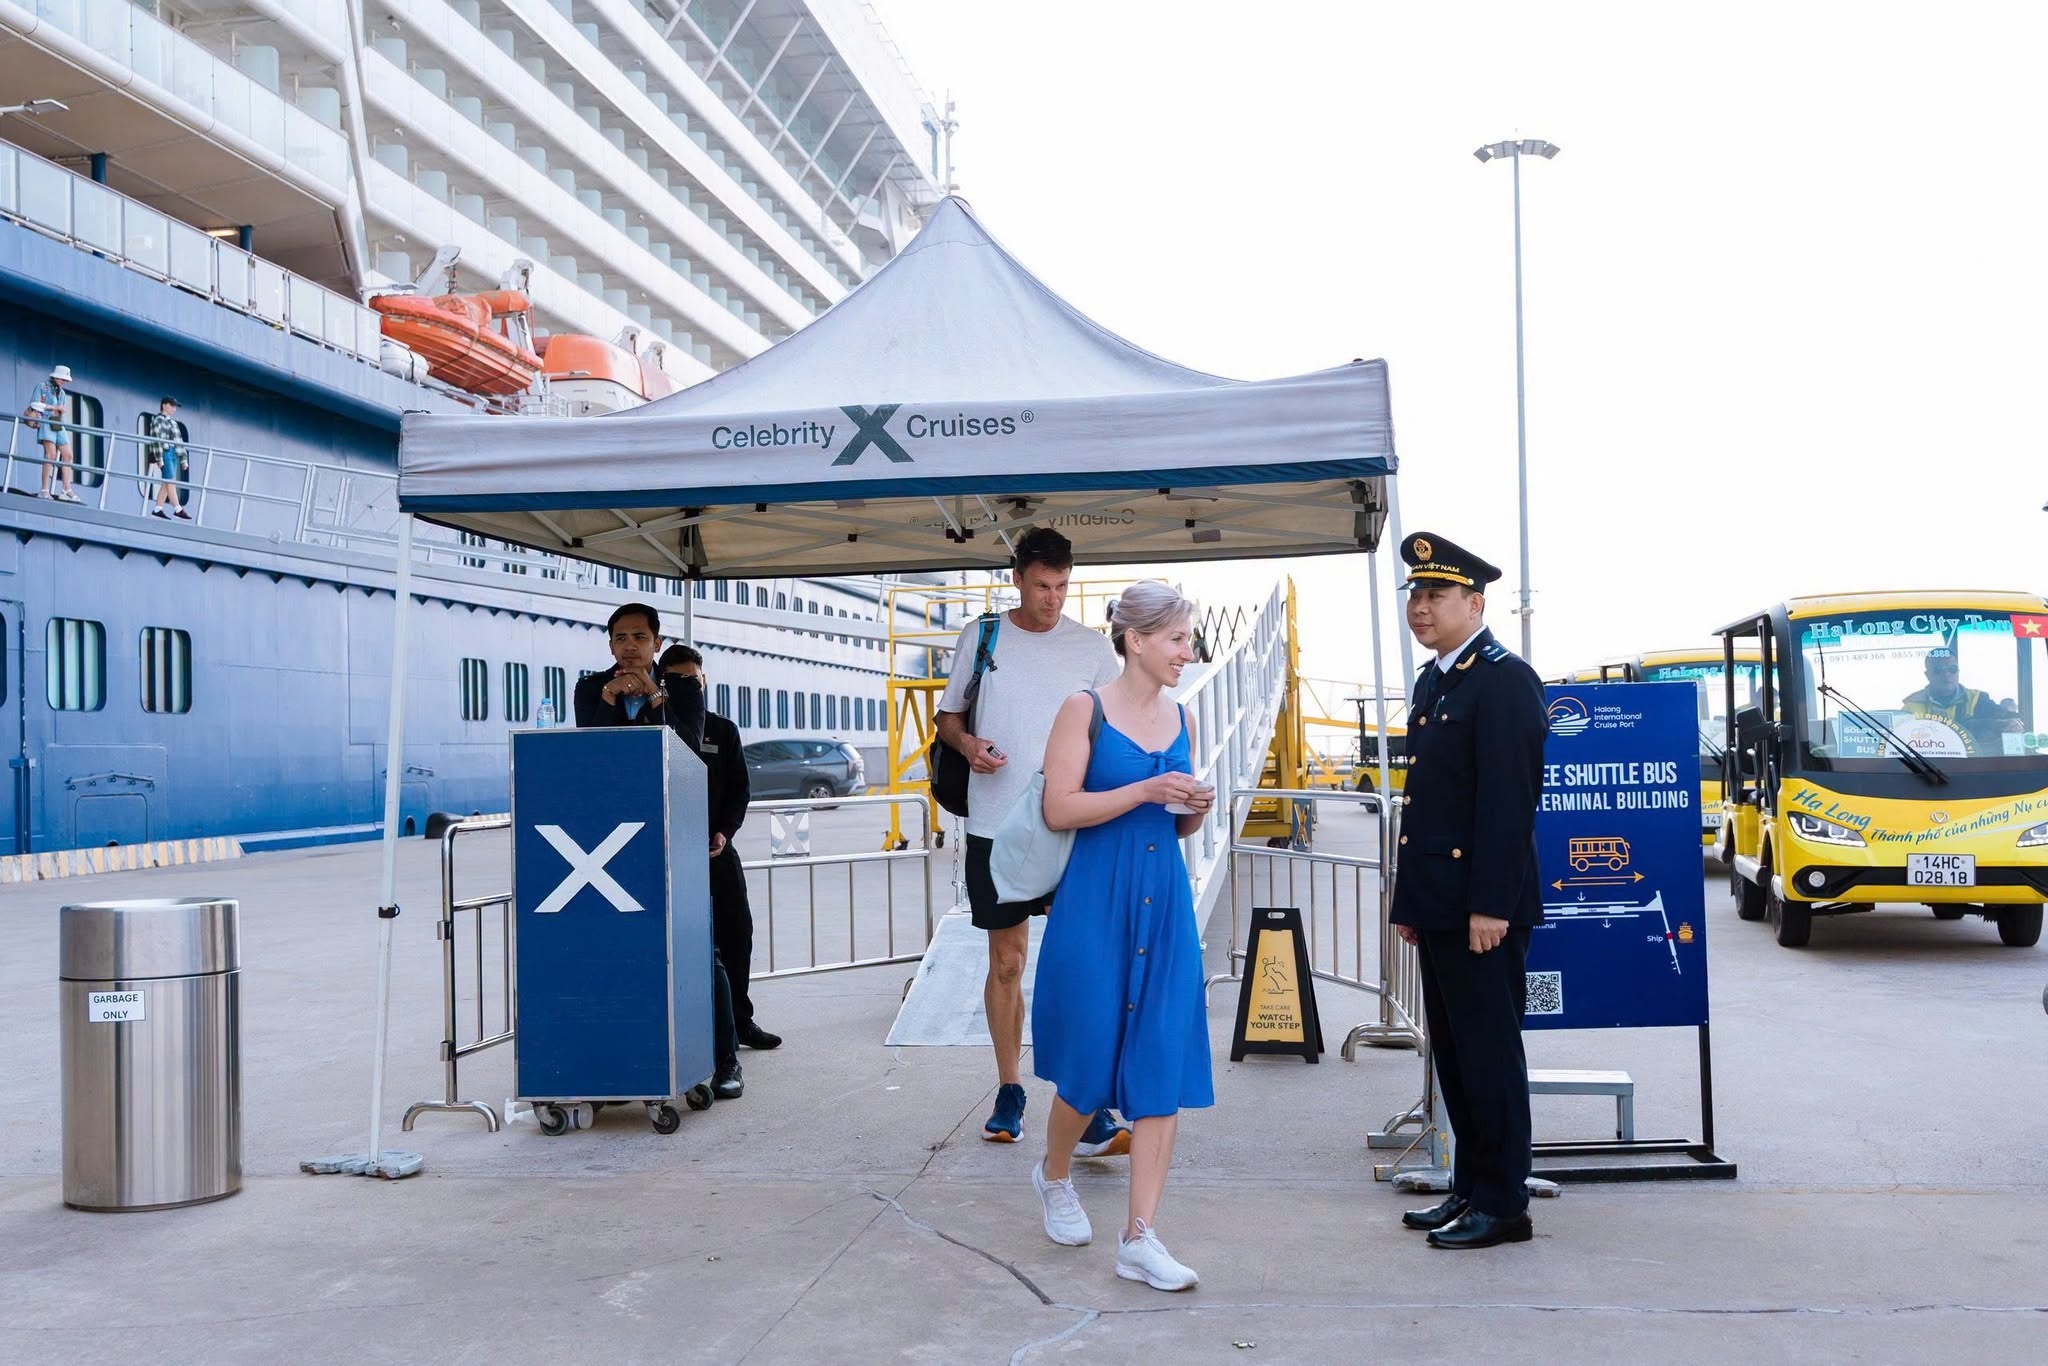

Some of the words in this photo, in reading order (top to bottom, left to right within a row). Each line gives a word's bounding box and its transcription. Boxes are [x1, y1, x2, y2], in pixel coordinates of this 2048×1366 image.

[712, 421, 835, 449] Celebrity
[906, 413, 1016, 438] Cruises
[1441, 564, 1460, 573] NAM
[1809, 619, 1906, 639] HaLong
[1909, 614, 1960, 648] City
[1964, 614, 2012, 631] Tou
[1594, 713, 1642, 721] International
[1856, 745, 1876, 754] BUS
[1543, 764, 1561, 786] EE
[1564, 762, 1640, 786] SHUTTLE
[1643, 761, 1678, 784] BUS
[1536, 792, 1612, 811] ERMINAL
[1616, 790, 1689, 810] BUILDING
[1793, 789, 1823, 812] Hạ
[1824, 802, 1871, 831] Long
[533, 822, 646, 913] X
[1924, 856, 1960, 869] 14HC
[1915, 871, 1967, 884] 028.18
[93, 994, 139, 1004] GARBAGE
[103, 1010, 128, 1019] ONLY
[1258, 1013, 1293, 1021] WATCH
[1250, 1021, 1276, 1029] YOUR
[1277, 1022, 1300, 1030] STEP
